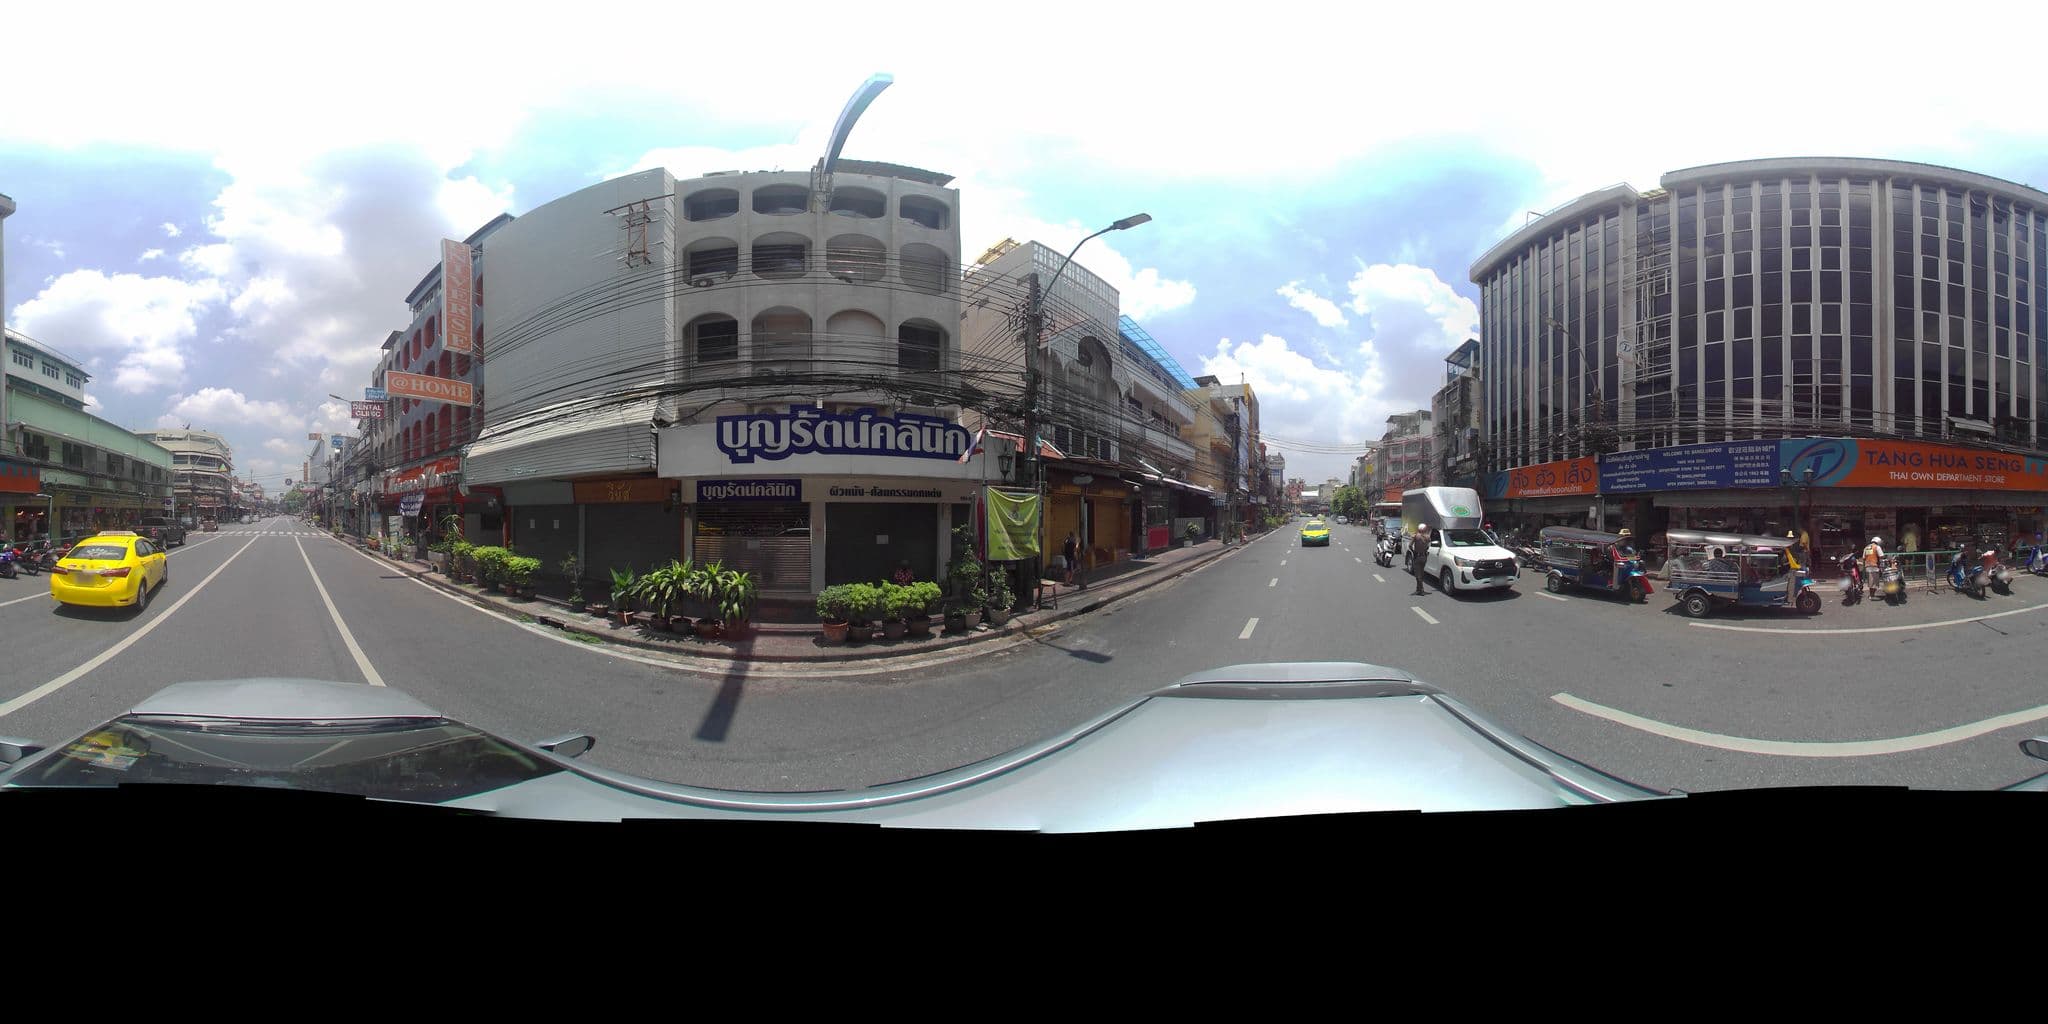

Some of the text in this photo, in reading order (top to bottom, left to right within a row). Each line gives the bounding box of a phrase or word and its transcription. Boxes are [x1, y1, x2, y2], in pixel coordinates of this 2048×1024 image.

[352, 403, 382, 411] DENTAL
[722, 409, 968, 457] บุญรัตน์คลินิก
[1866, 450, 2021, 472] TANG HUA SENG
[1889, 471, 2005, 484] THAI OWN DEPARTMENT STORE
[703, 481, 796, 500] บุญรัตน์คลินิก
